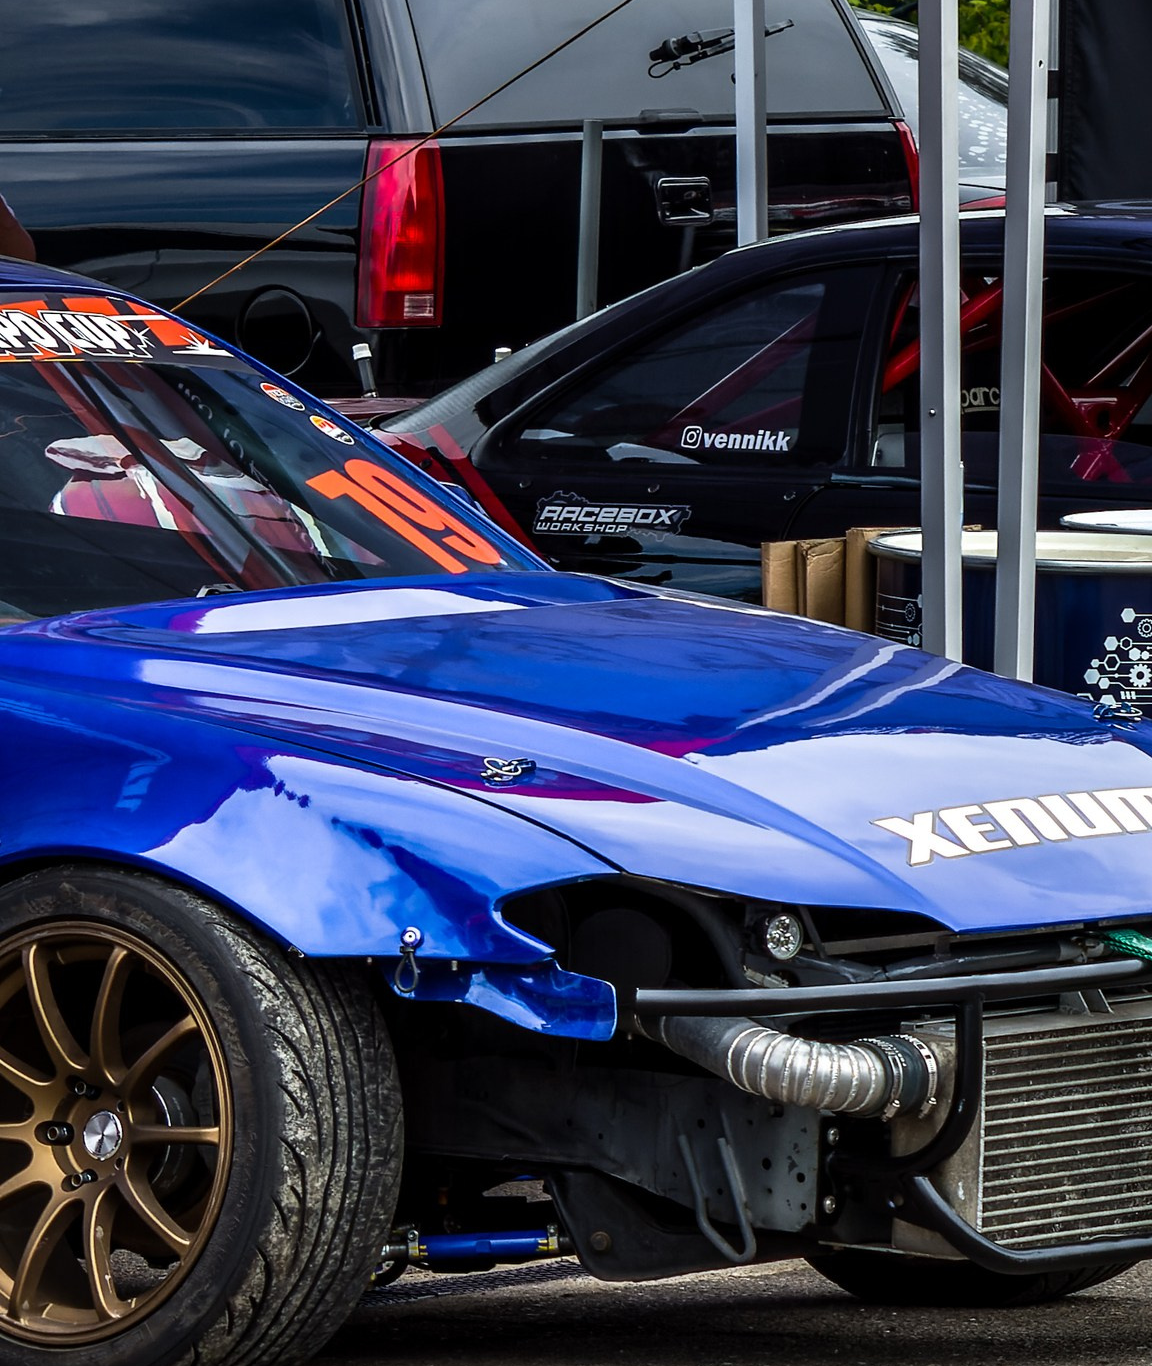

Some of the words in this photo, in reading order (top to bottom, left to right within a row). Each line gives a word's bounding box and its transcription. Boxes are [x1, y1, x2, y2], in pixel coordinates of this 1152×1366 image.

[42, 313, 137, 351] CUP
[960, 386, 1000, 407] parc
[703, 429, 791, 451] vennikk
[305, 458, 502, 575] 19
[539, 505, 678, 525] RACEBOX
[535, 521, 628, 533] WORKSHOP
